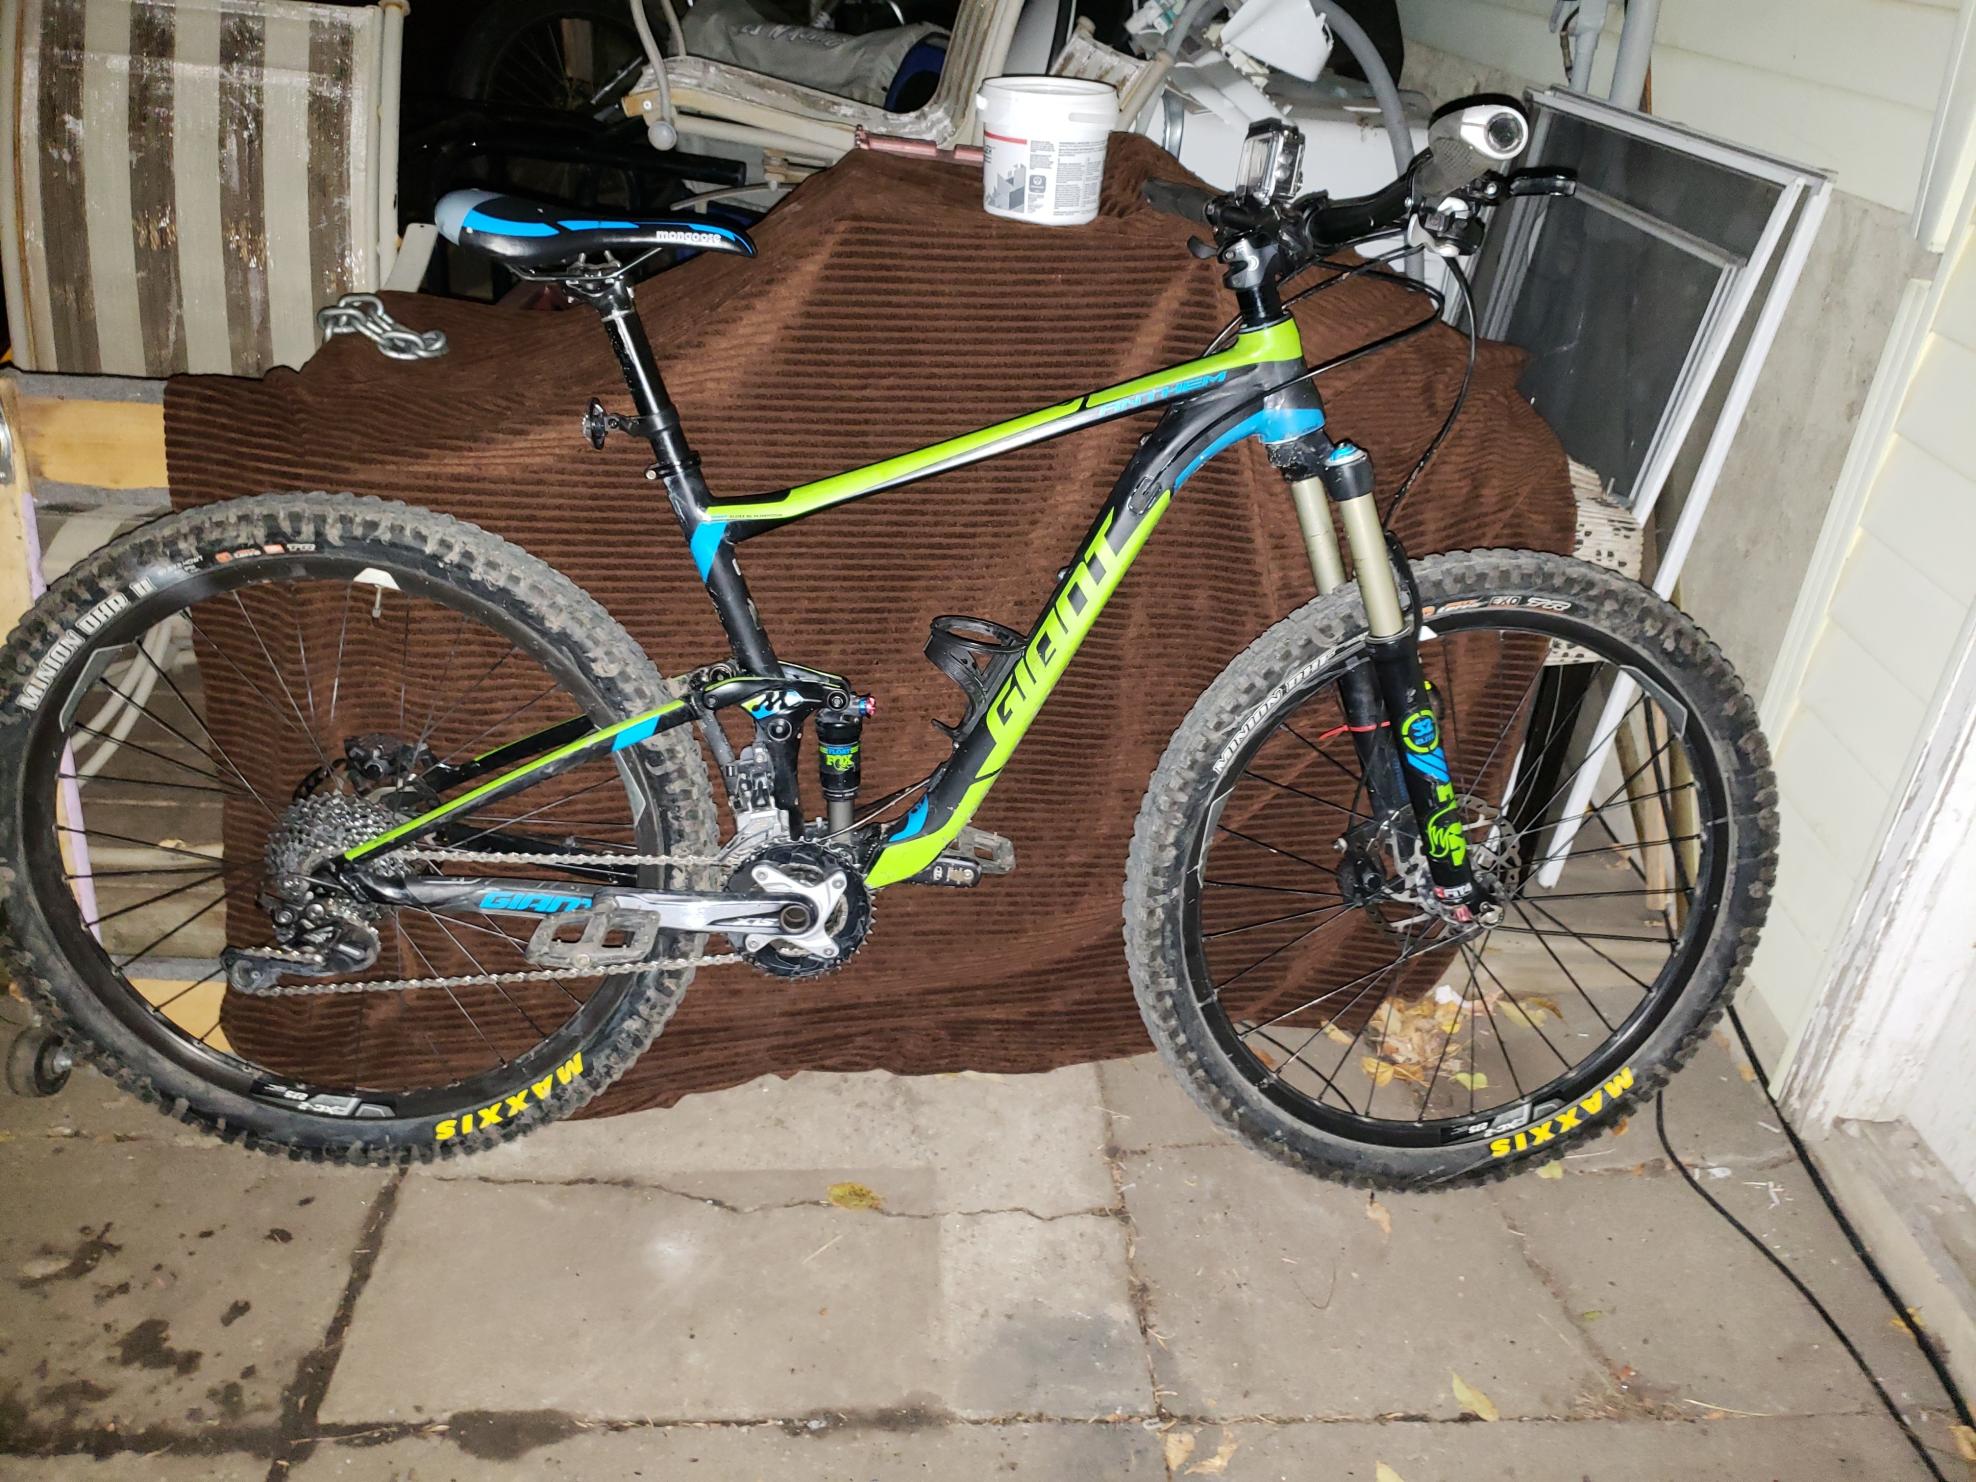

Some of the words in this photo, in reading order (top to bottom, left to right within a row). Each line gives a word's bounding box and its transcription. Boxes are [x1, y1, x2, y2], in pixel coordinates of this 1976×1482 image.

[656, 230, 721, 243] mongoose
[1099, 370, 1228, 418] ANTHEM
[16, 628, 86, 712] MINION
[826, 753, 855, 772] FOX
[1212, 686, 1284, 777] MINION
[434, 1051, 584, 1142] MAXXIS
[1489, 1066, 1635, 1159] MAXXIS
